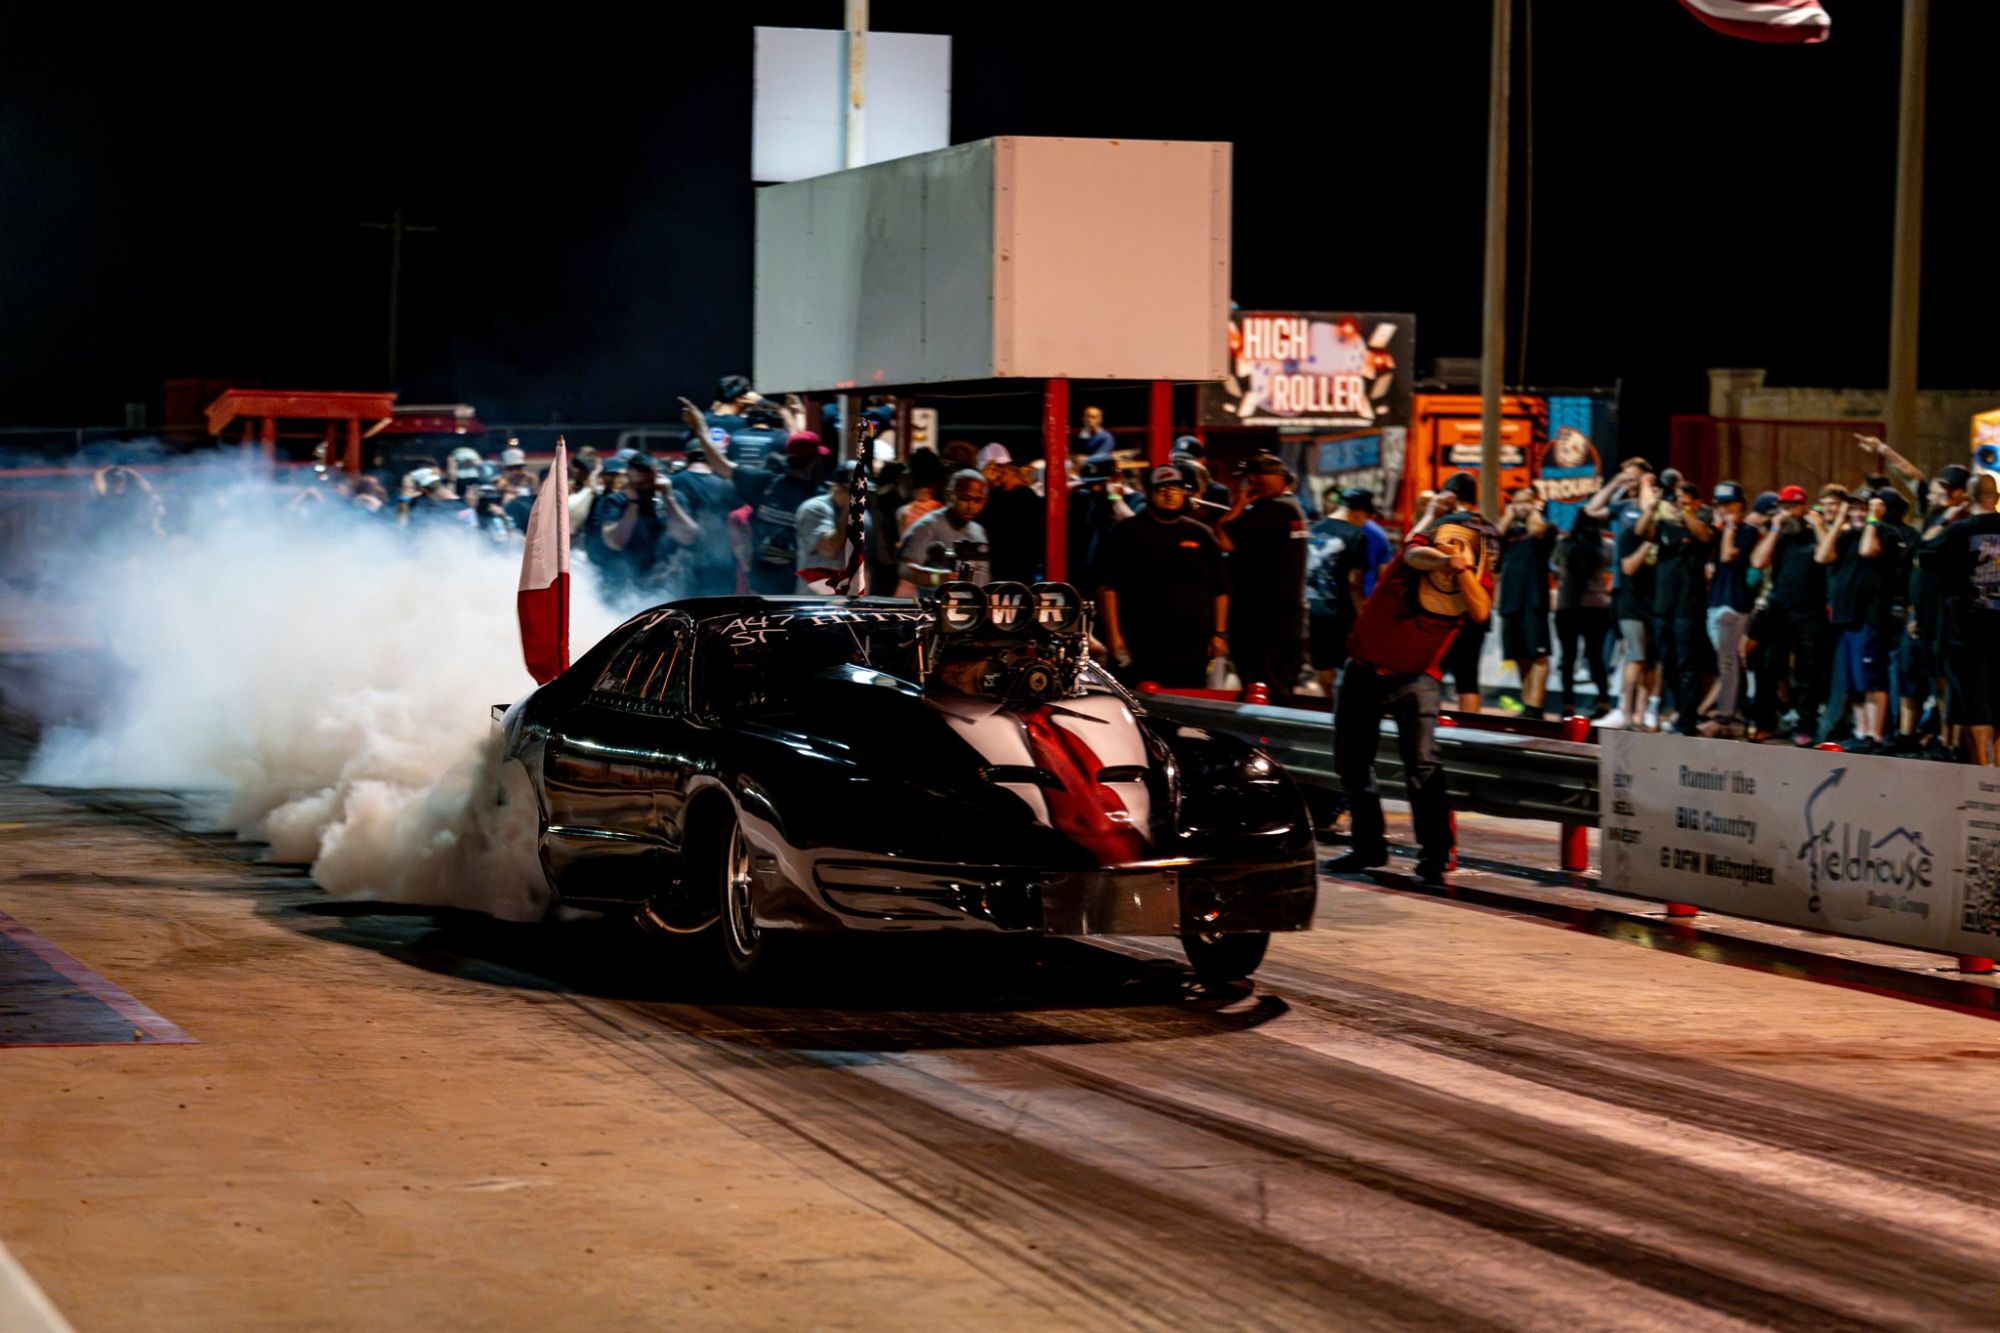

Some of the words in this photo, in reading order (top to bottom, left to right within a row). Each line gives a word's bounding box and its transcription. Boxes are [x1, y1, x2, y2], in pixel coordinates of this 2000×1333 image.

[1243, 317, 1309, 360] HIGH
[1272, 374, 1366, 413] ROLLER
[1675, 805, 1700, 831] BIG
[1703, 809, 1758, 845] Country
[1704, 852, 1777, 888] Metroplex
